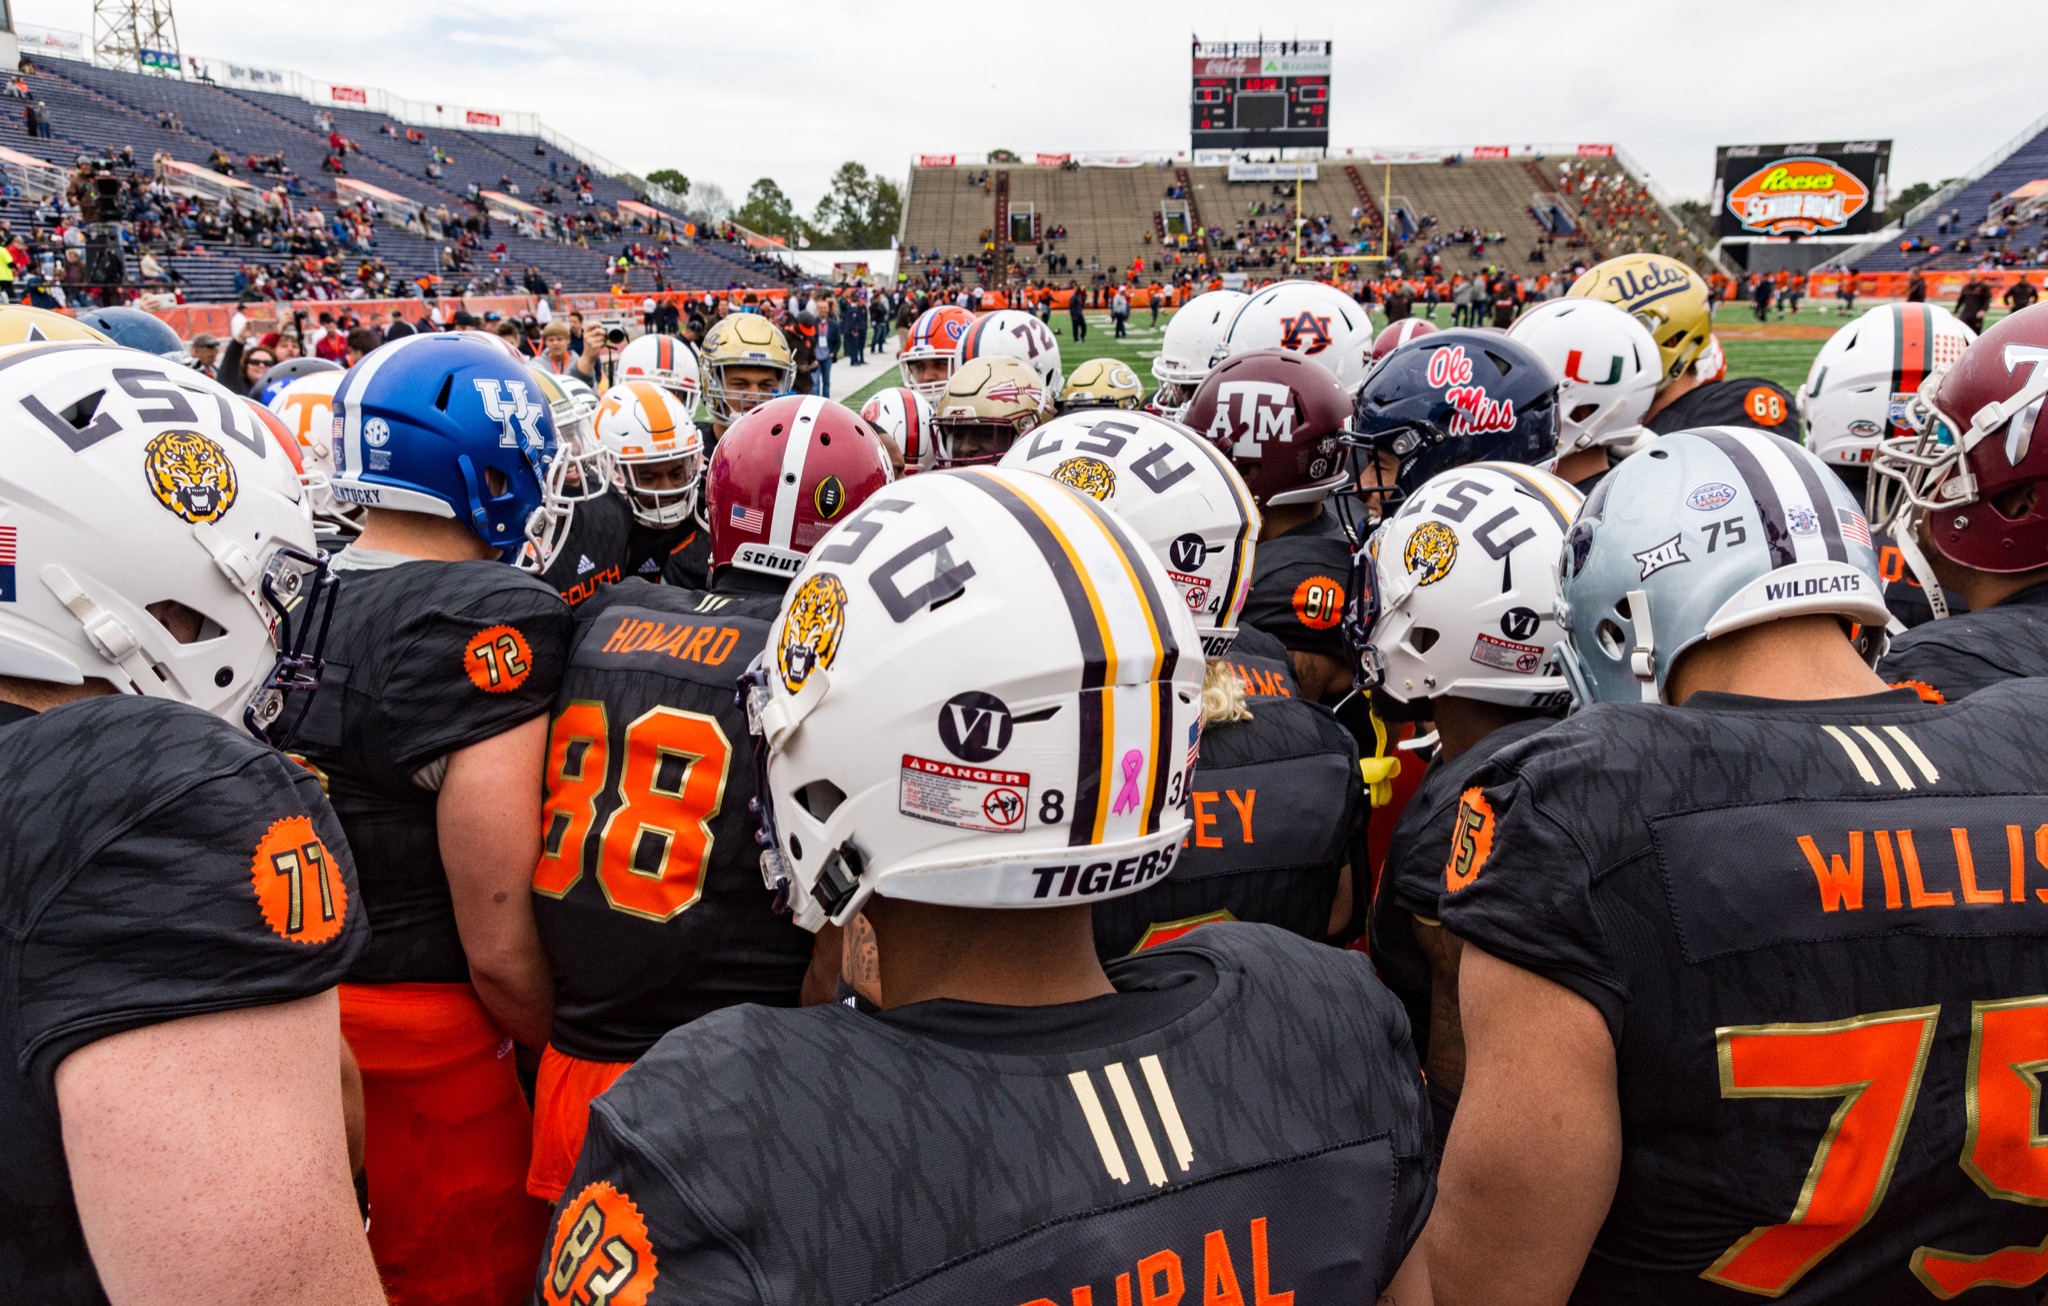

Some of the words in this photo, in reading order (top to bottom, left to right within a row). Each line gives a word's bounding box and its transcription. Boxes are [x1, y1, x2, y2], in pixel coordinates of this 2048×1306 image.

[1011, 319, 1054, 359] 72
[1427, 346, 1473, 388] Ole
[473, 379, 544, 449] UK
[1445, 386, 1517, 436] Miss
[1754, 393, 1781, 419] 68
[364, 418, 390, 447] SEC
[1026, 421, 1196, 494] LSU
[1692, 488, 1731, 505] TEXAS
[1176, 540, 1204, 566] VI
[1701, 516, 1747, 554] 75
[742, 550, 802, 572] schut
[816, 499, 977, 623] SU
[1169, 573, 1208, 586] ANGER
[1208, 596, 1221, 615] 4
[1304, 585, 1335, 622] 81
[1765, 574, 1861, 601] WILDCATS
[602, 618, 740, 666] HOWARD
[1508, 611, 1537, 636] VI
[473, 632, 528, 687] 72
[1200, 636, 1233, 657] TIGE
[1490, 638, 1539, 653] DANGER
[947, 703, 1008, 752] VI
[924, 762, 1021, 784] DANGER
[532, 699, 733, 923] 88
[1039, 789, 1064, 825] 8
[1182, 789, 1256, 848] EY
[271, 840, 336, 934] 77
[1033, 843, 1176, 899] TIGERS
[1699, 994, 2048, 1300] 75
